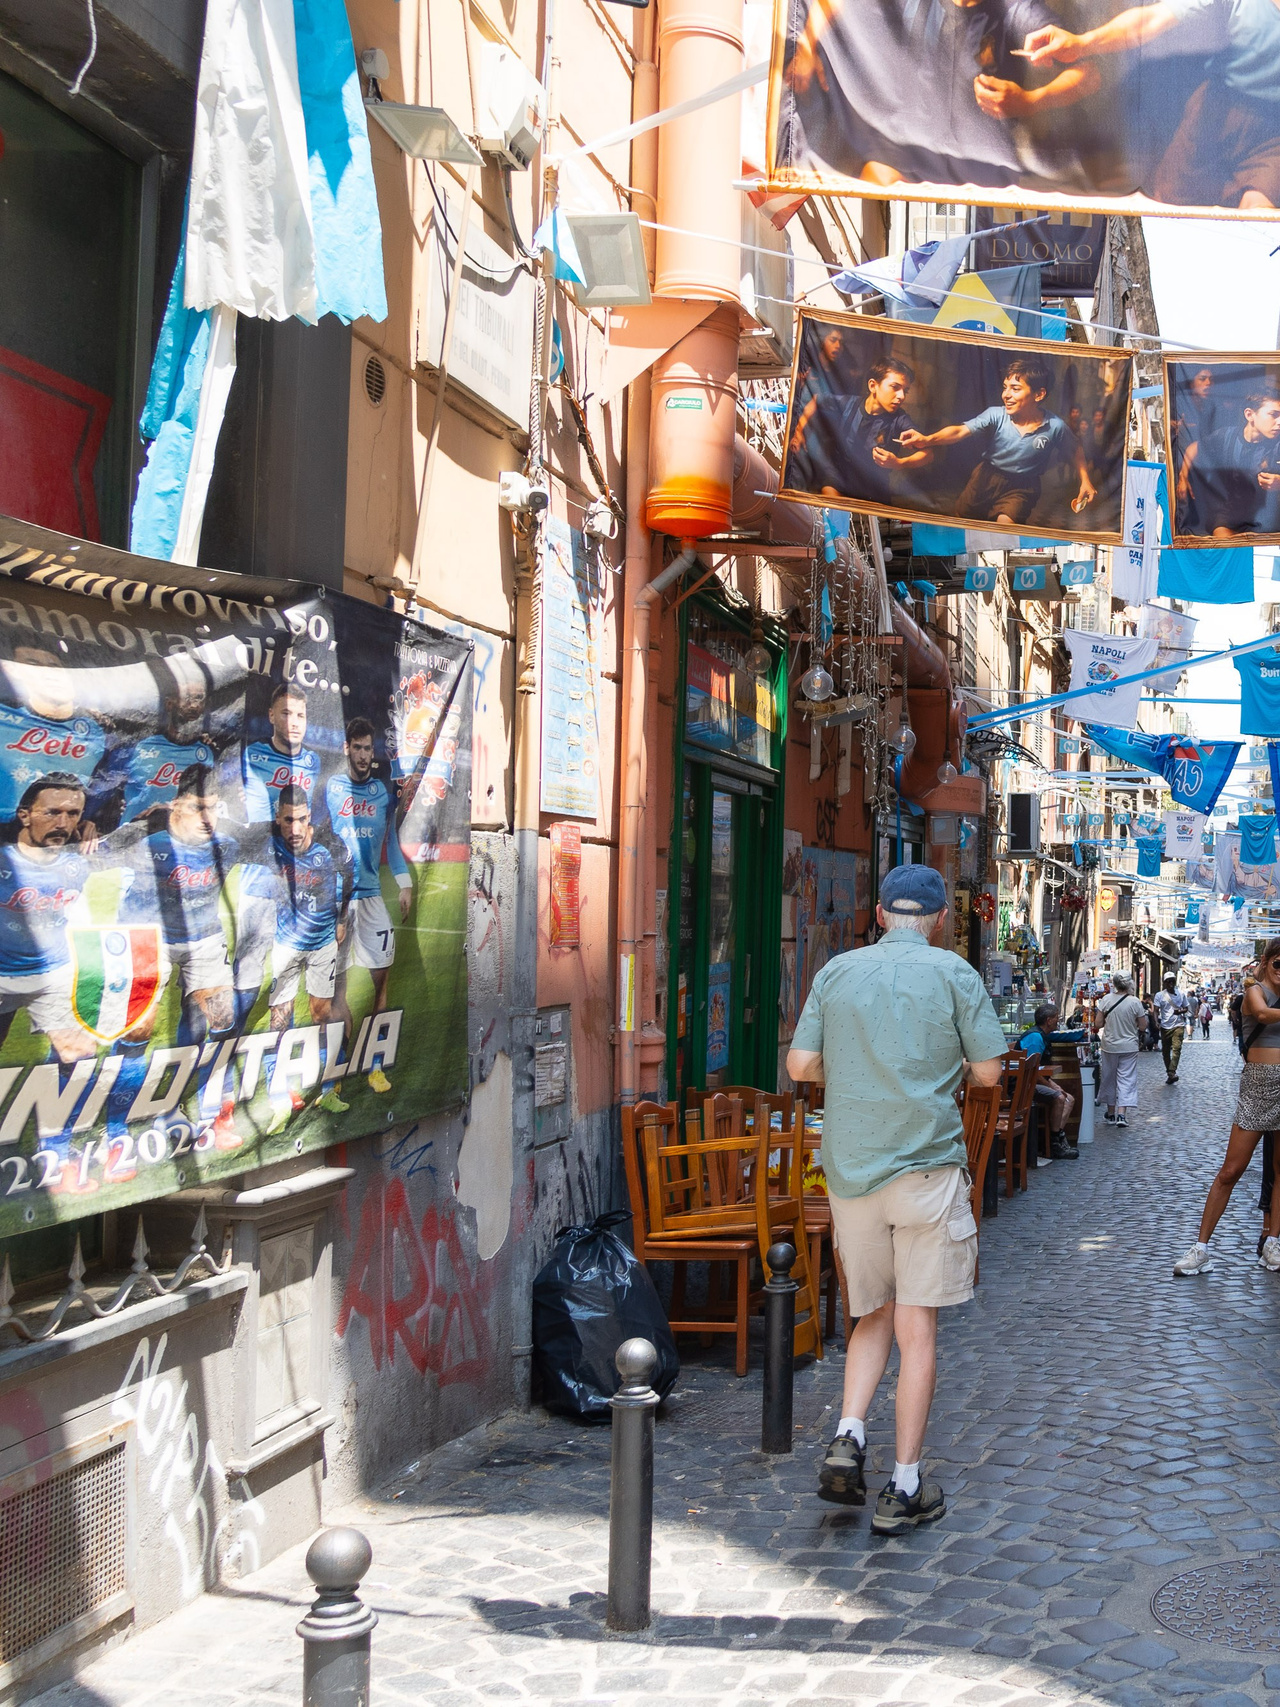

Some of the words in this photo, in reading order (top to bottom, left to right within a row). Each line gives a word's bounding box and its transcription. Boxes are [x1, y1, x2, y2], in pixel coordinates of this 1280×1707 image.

[992, 238, 1093, 261] DUOMO
[236, 636, 276, 678] di
[1091, 644, 1127, 660] NAPOLI
[7, 727, 87, 759] Lete
[250, 754, 269, 764] EA7
[266, 766, 312, 791] Lete
[337, 796, 377, 818] Lete
[125, 1009, 404, 1125] D'ITALIA
